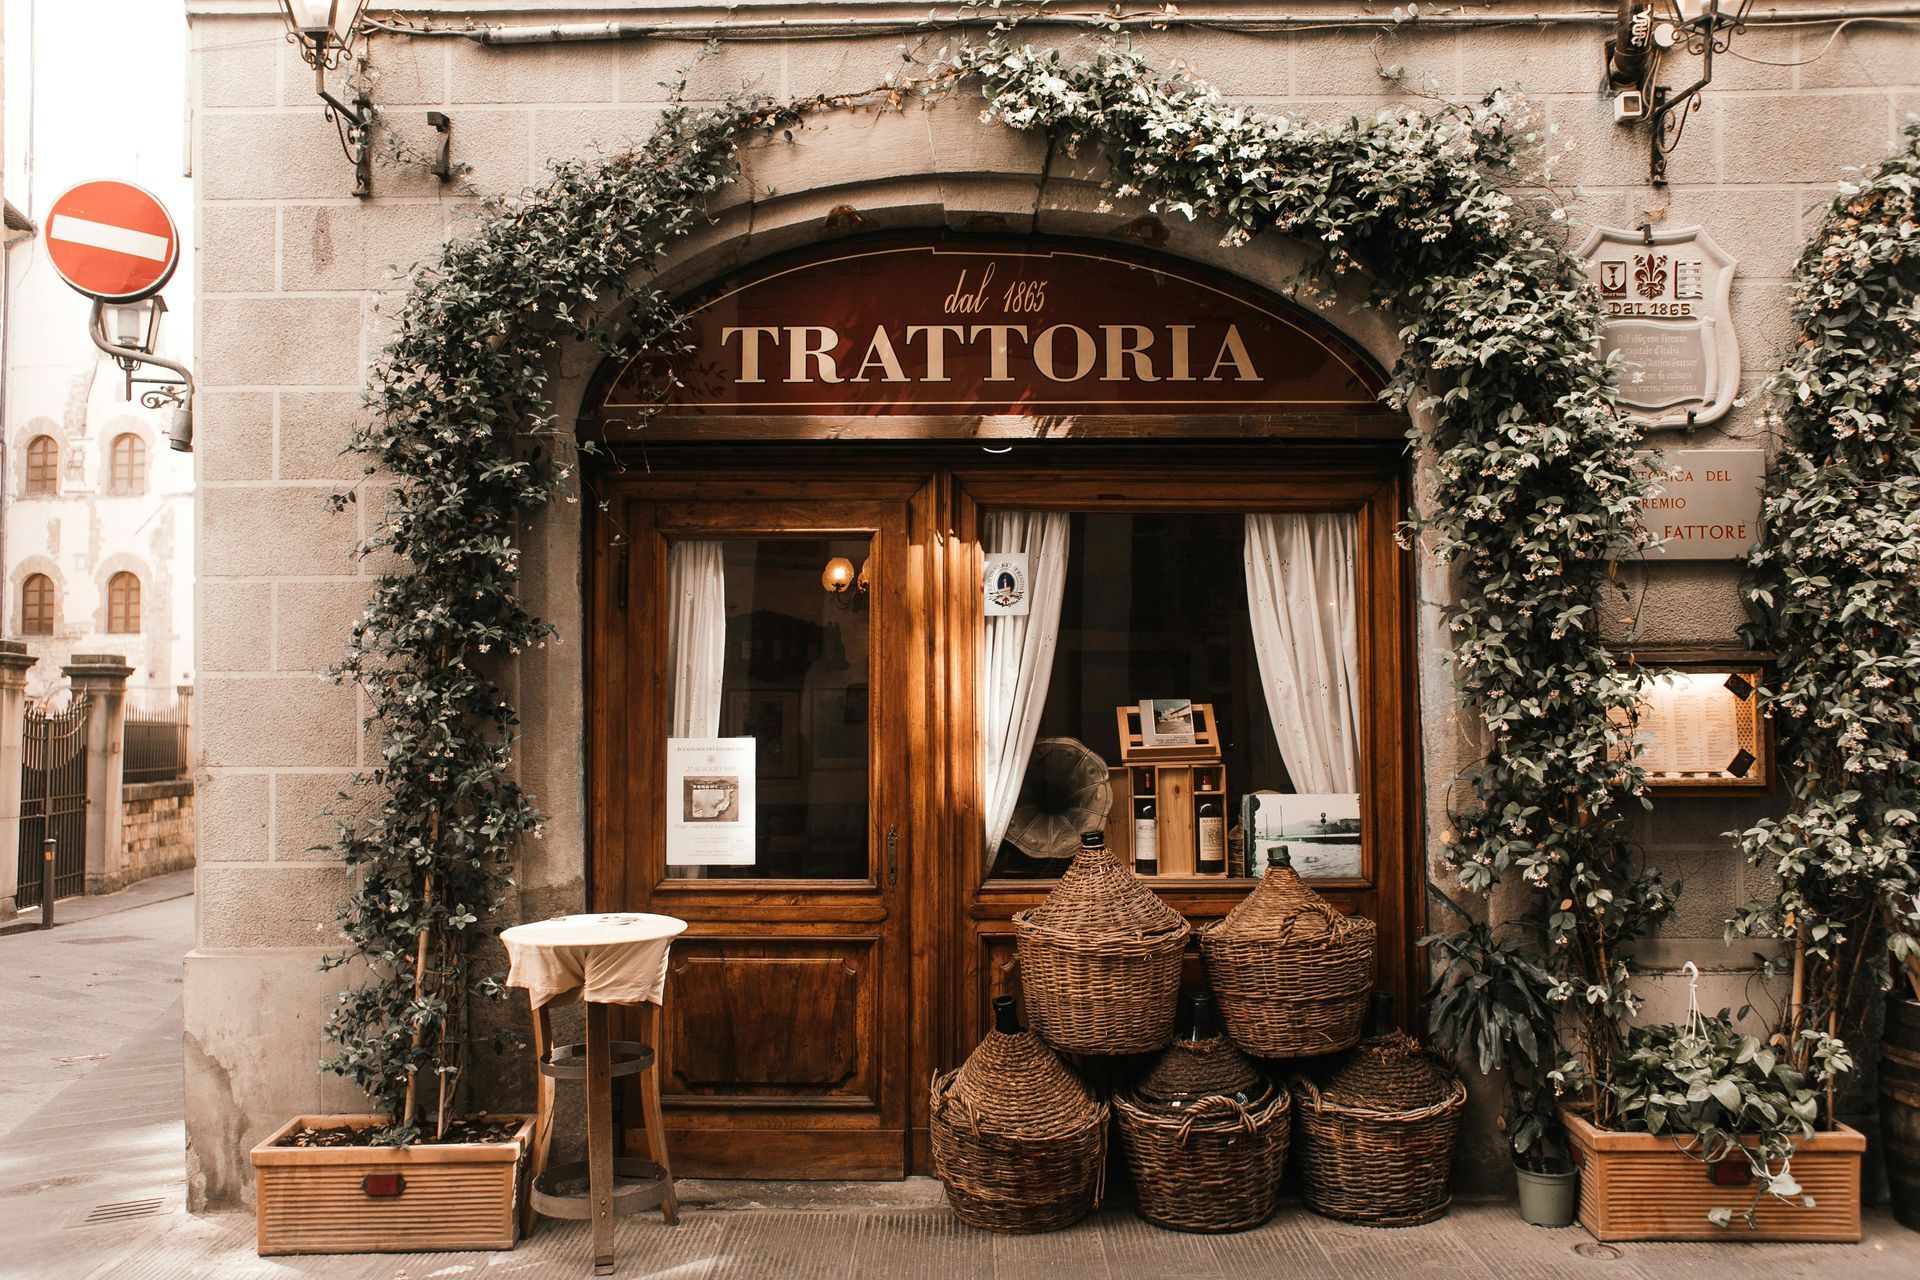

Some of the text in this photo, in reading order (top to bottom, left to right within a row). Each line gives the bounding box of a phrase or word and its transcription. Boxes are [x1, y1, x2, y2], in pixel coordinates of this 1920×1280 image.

[944, 261, 1048, 313] dal 1865
[1650, 302, 1690, 315] 1865
[721, 323, 1264, 383] TRATTORIA
[1706, 470, 1732, 481] DEL
[1664, 525, 1747, 539] FATTORE
